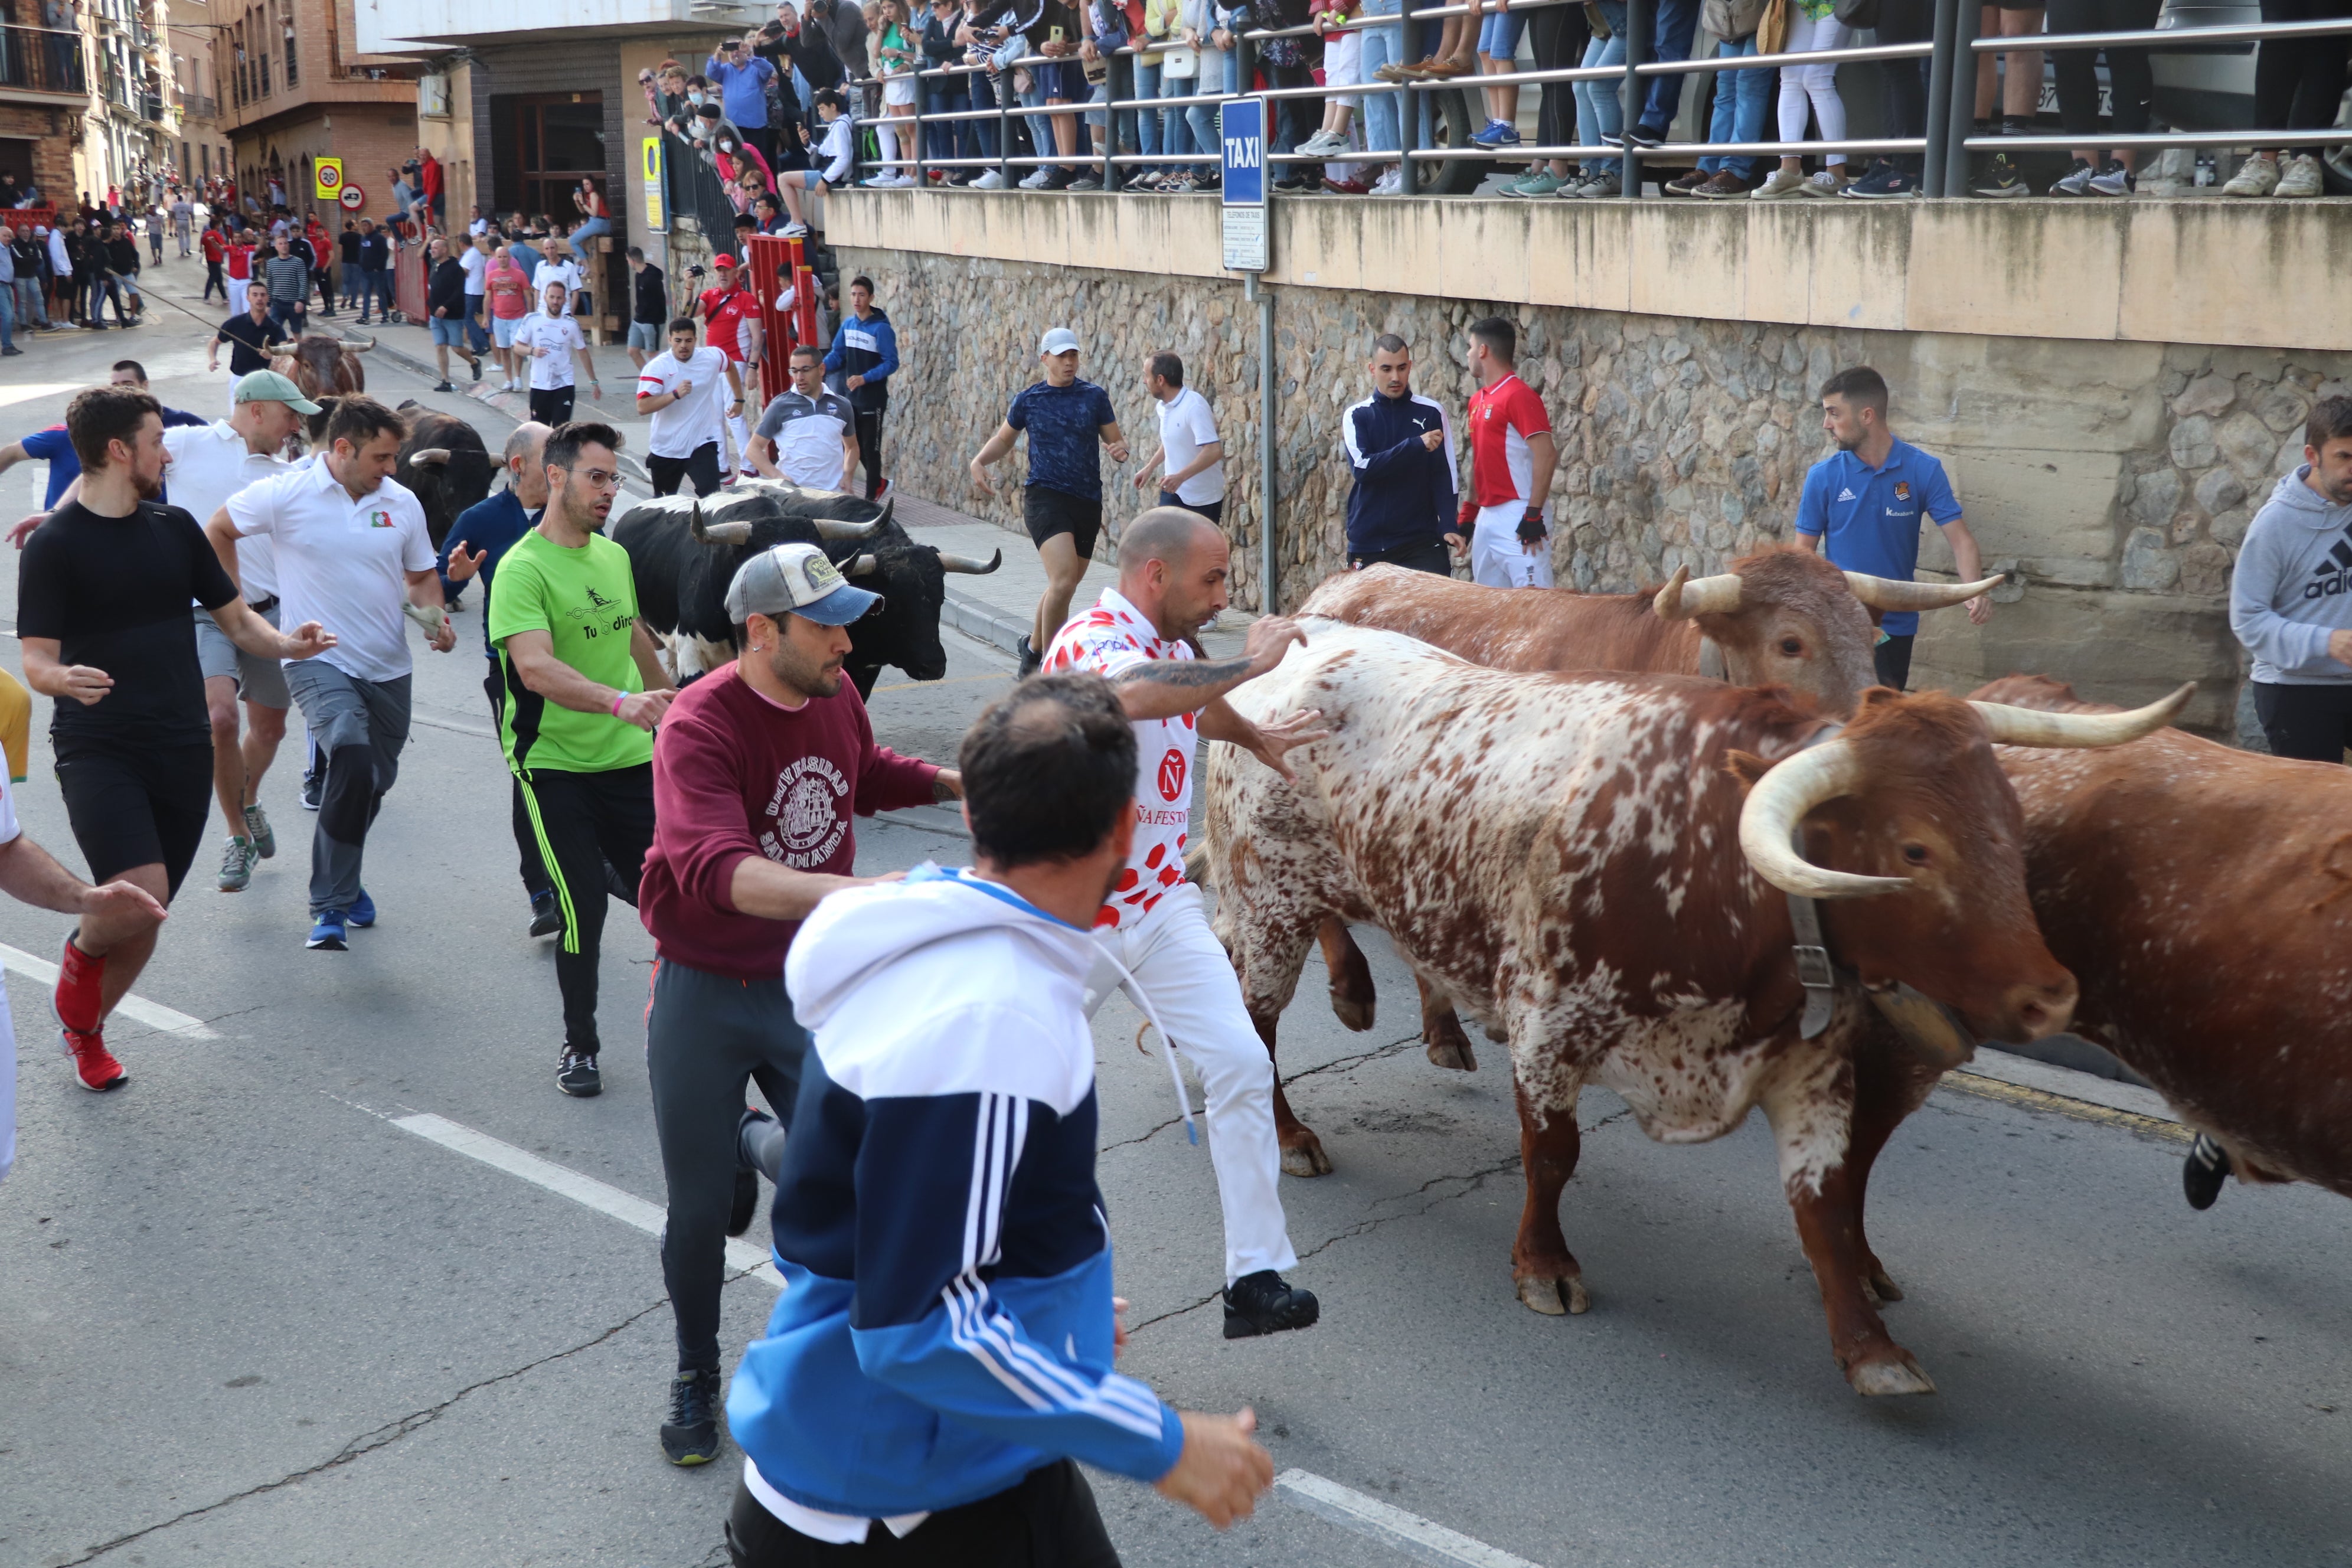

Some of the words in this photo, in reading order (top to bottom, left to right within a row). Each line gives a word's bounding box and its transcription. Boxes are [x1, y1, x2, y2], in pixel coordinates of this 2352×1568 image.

[1225, 137, 1259, 168] TAXI
[584, 626, 597, 639] Tu
[1162, 754, 1181, 794] Ñ
[760, 821, 848, 868] SALAMANCA
